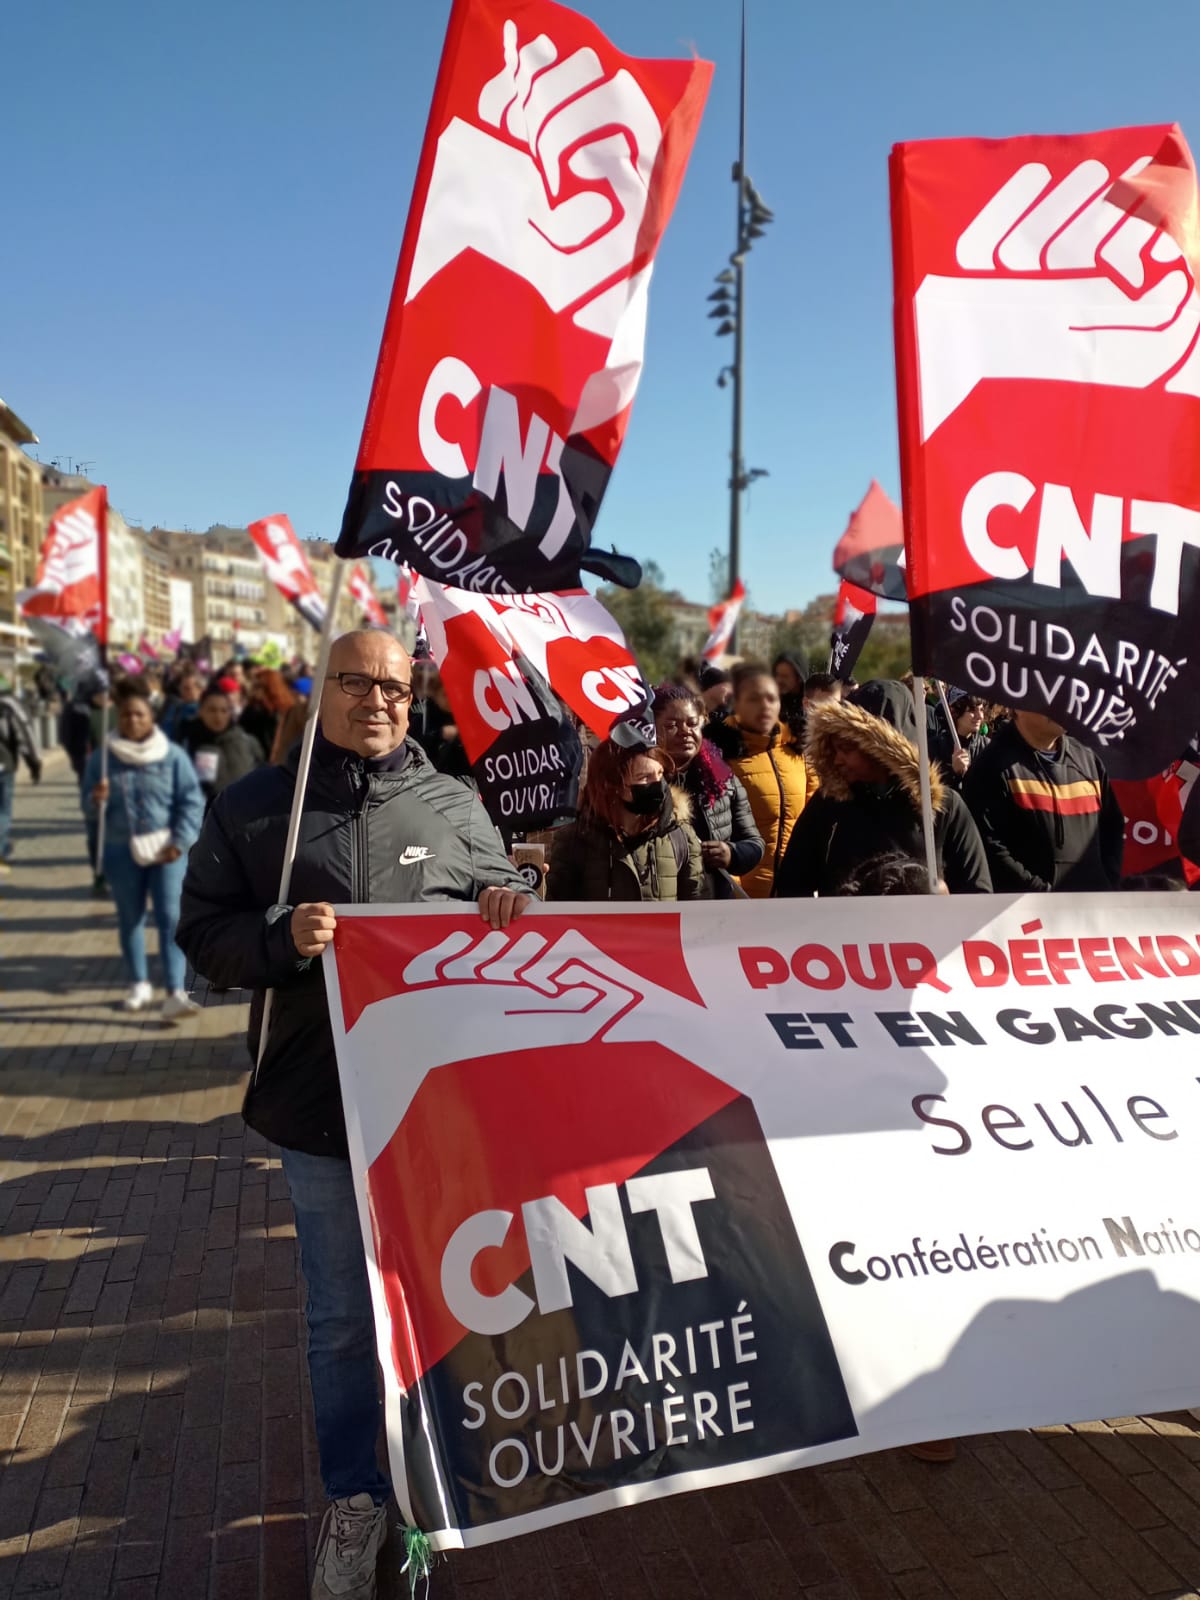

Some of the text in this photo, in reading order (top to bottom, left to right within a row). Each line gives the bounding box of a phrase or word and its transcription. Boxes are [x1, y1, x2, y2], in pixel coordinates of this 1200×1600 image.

[961, 471, 1200, 616] CNT
[404, 846, 429, 857] NIKE
[738, 918, 1200, 994] POUR DÉFEND
[765, 1012, 858, 1050] ET
[874, 1011, 988, 1048] EN
[911, 1085, 1179, 1156] Seule
[440, 1167, 716, 1336] CNT
[828, 1227, 1103, 1286] Confédération
[461, 1300, 758, 1430] SOLIDARITÉ
[488, 1382, 755, 1488] OUVRIÈRE
